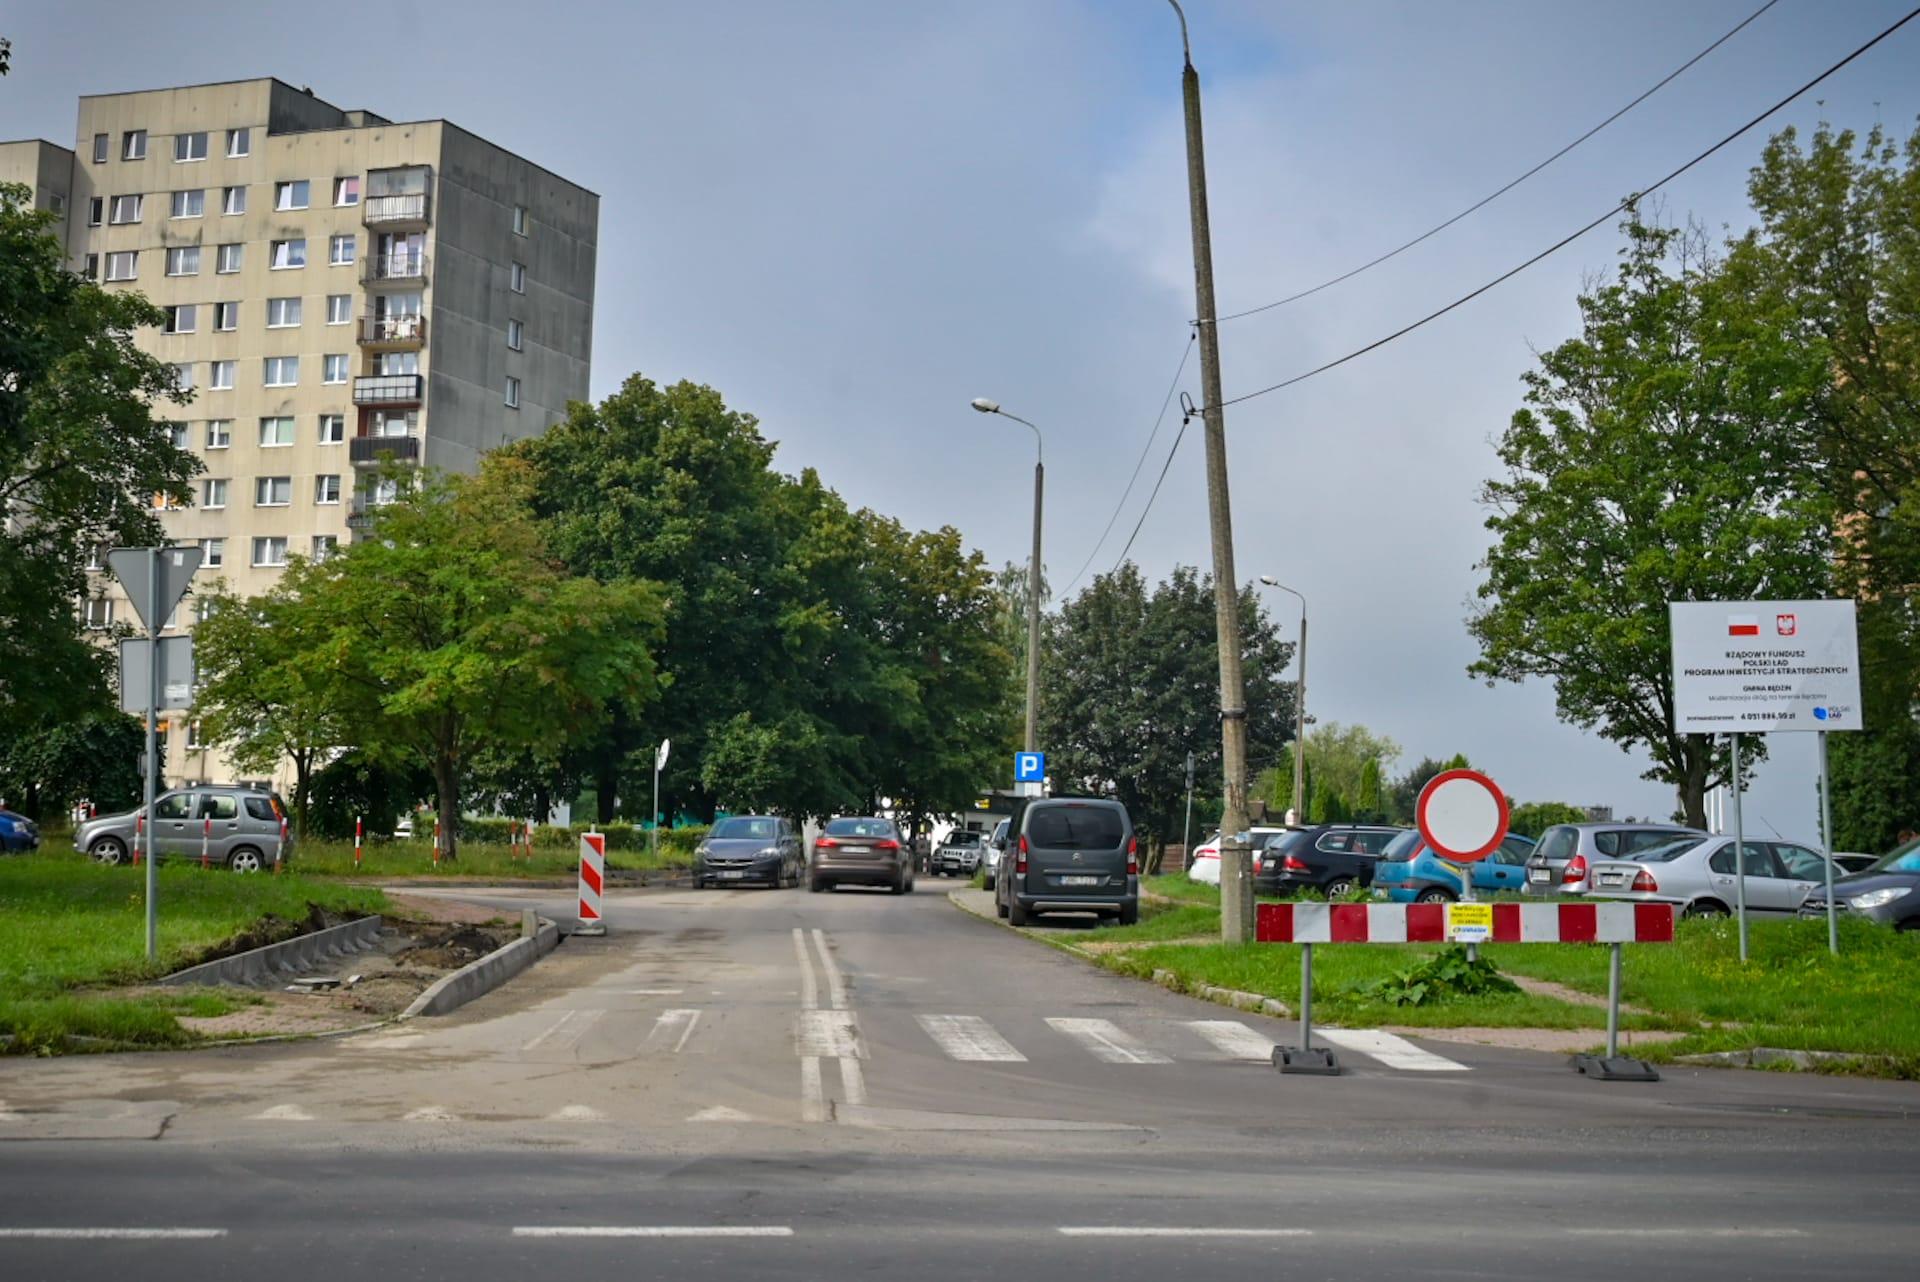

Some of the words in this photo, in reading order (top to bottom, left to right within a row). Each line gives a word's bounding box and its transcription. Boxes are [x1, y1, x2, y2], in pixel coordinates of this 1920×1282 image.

[1768, 650, 1806, 658] FUNDUSZ
[1726, 668, 1775, 676] INWESTYCJI
[1776, 666, 1848, 675] STRATEGICZNYCH
[1767, 685, 1792, 693] BĘDZIN
[1021, 756, 1037, 777] P
